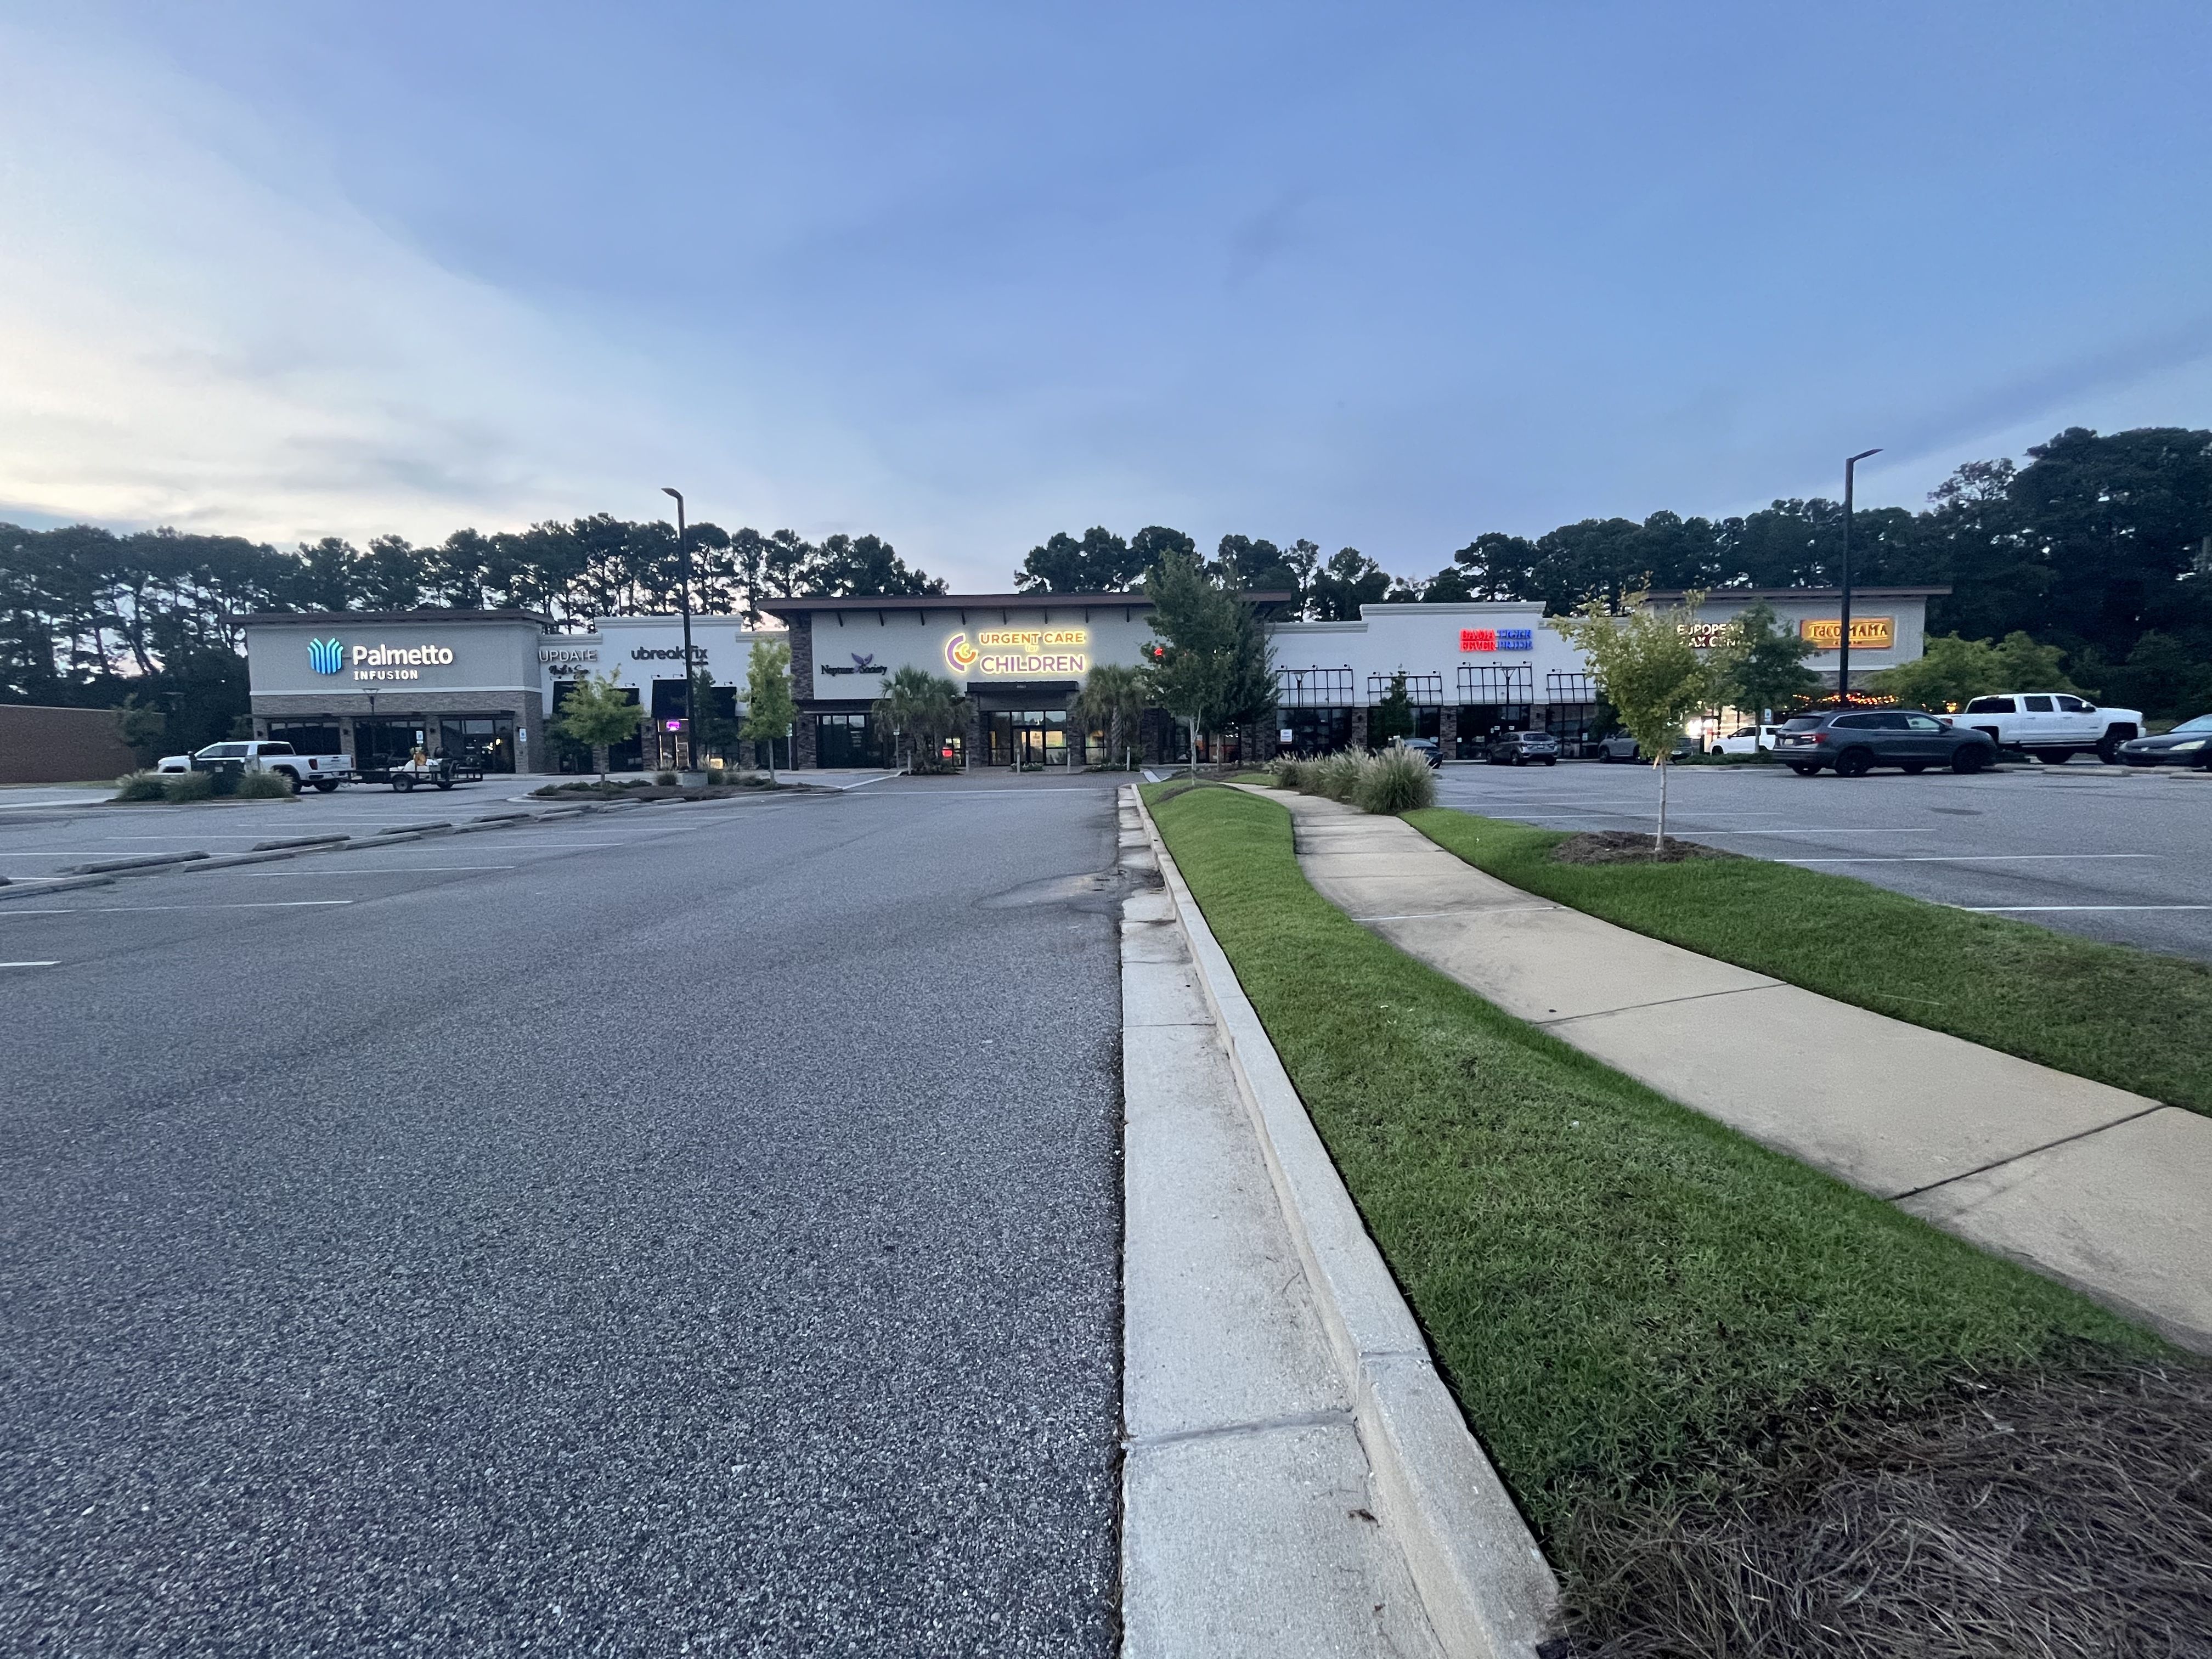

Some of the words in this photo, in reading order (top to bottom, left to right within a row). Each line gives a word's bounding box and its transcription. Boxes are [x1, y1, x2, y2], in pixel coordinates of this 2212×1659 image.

[980, 633, 1039, 644] URGENT
[1044, 633, 1084, 643] CARE
[1460, 629, 1494, 640] BAMA
[1497, 629, 1531, 639] TIGER
[1460, 640, 1496, 651] FEVER
[1498, 640, 1533, 651] PRIDE
[353, 644, 453, 665] Palmetto
[539, 649, 597, 662] UPDATE
[631, 645, 708, 660] ubreakfix
[981, 656, 1084, 672] CHILDREN
[354, 670, 418, 680] INFUSION
